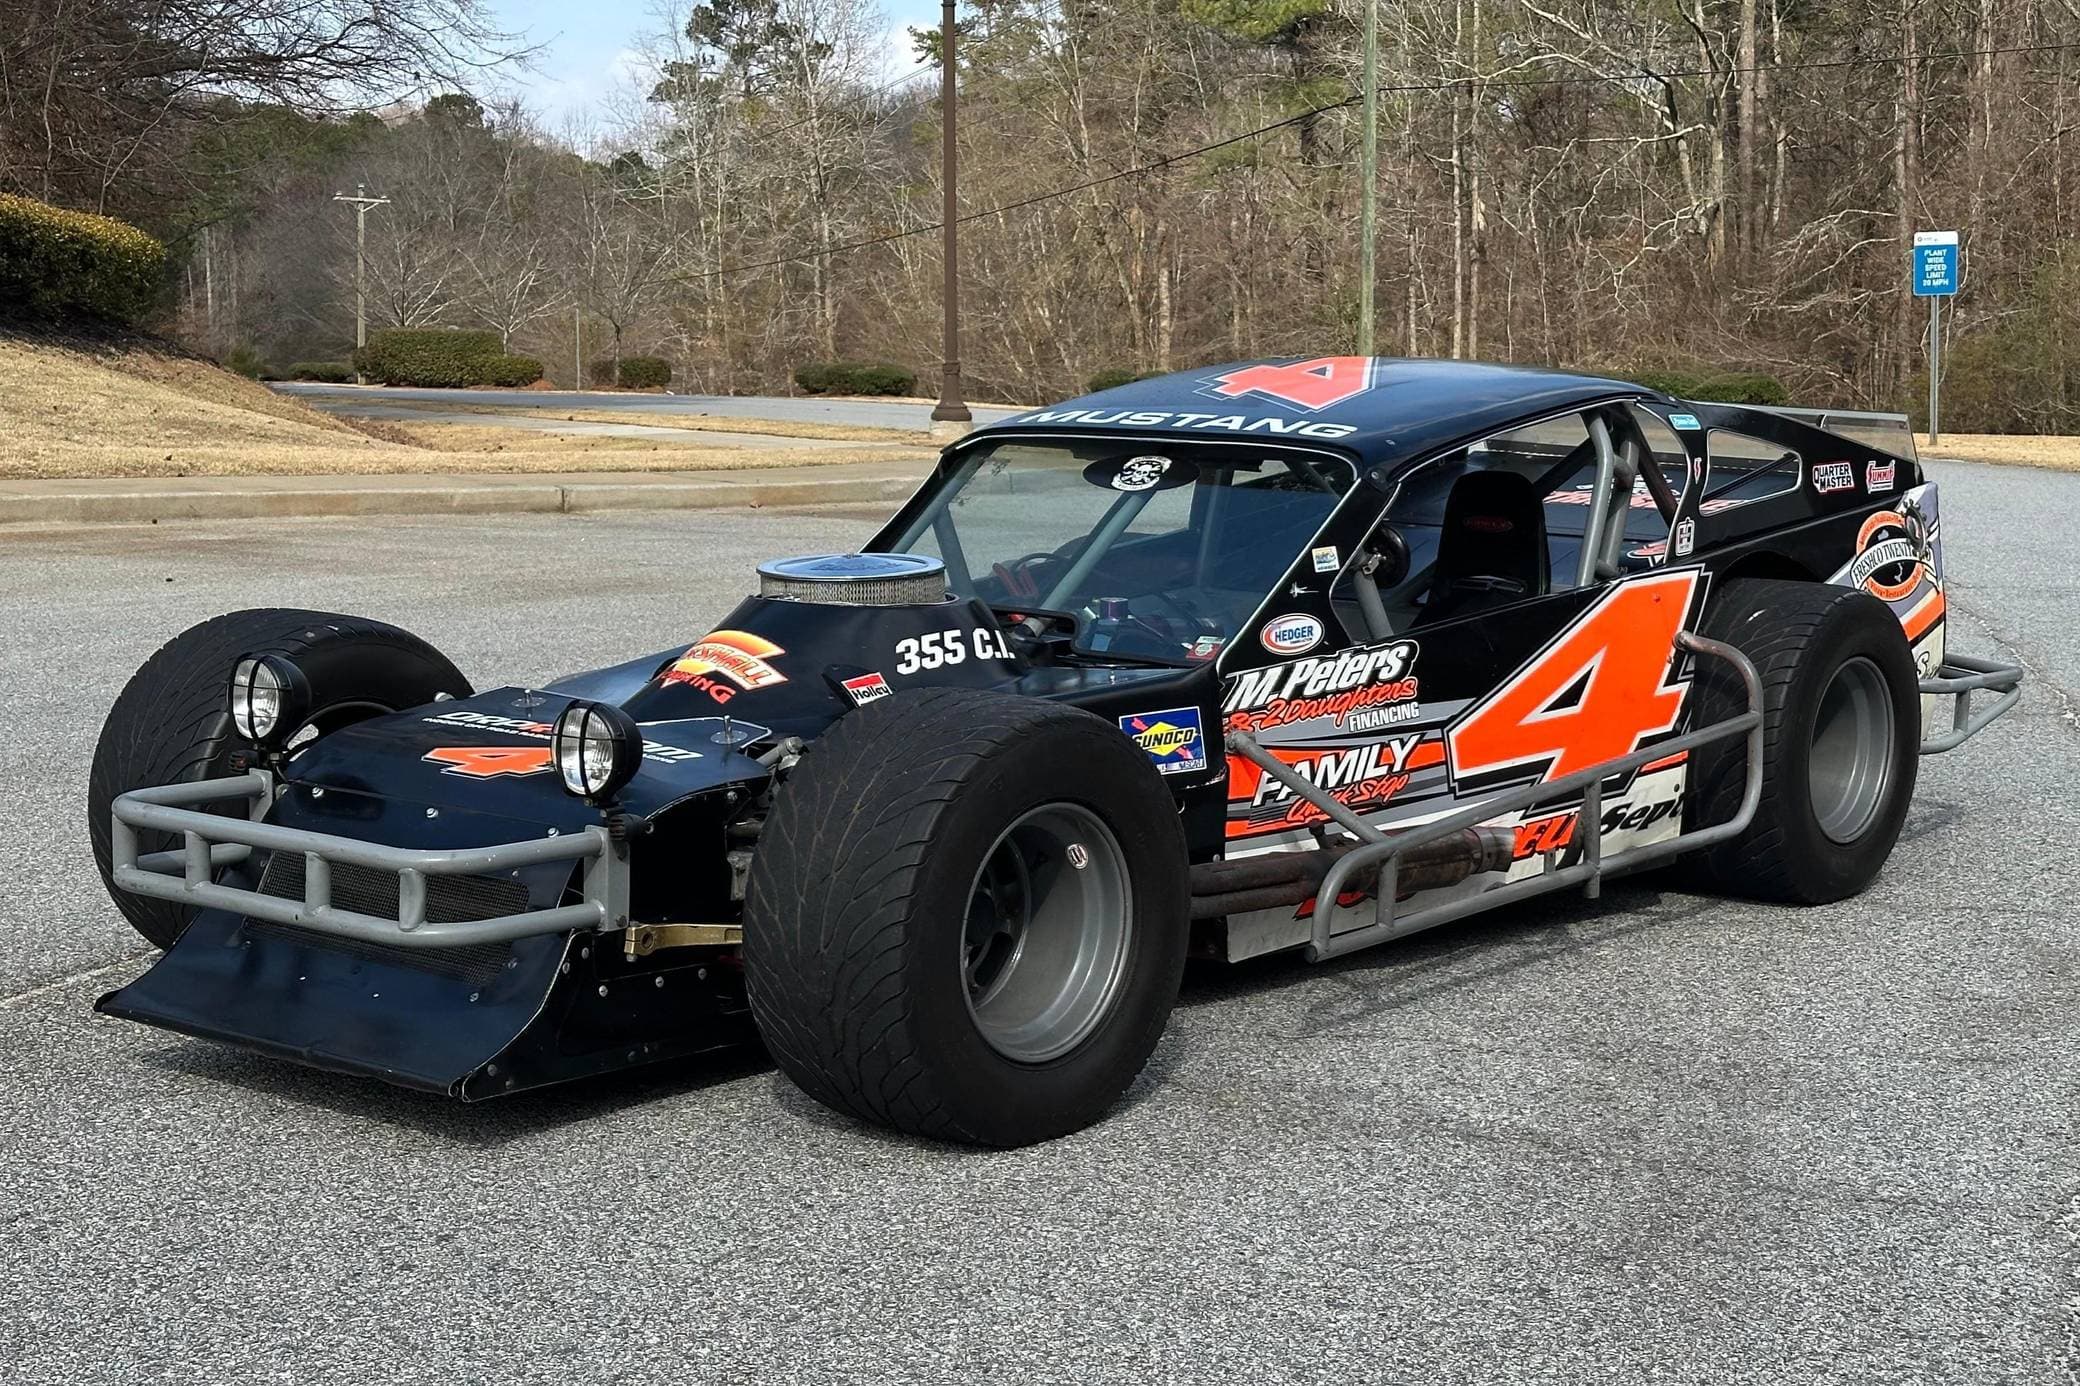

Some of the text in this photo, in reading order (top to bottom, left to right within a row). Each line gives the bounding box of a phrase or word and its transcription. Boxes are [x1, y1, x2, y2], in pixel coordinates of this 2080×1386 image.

[1200, 356, 1376, 413] 4
[1017, 410, 1358, 438] MUSTANG
[1814, 464, 1850, 484] QUARTER
[1820, 476, 1852, 491] MASTER
[1274, 625, 1313, 642] HEDGER
[896, 638, 966, 675] 355
[1448, 566, 1706, 787] 4
[851, 685, 890, 700] Holley
[1260, 700, 1288, 730] 2
[1283, 678, 1418, 729] Daughters
[1349, 702, 1420, 733] FINANCING
[421, 746, 553, 780] 4
[1351, 773, 1411, 804] Stop
